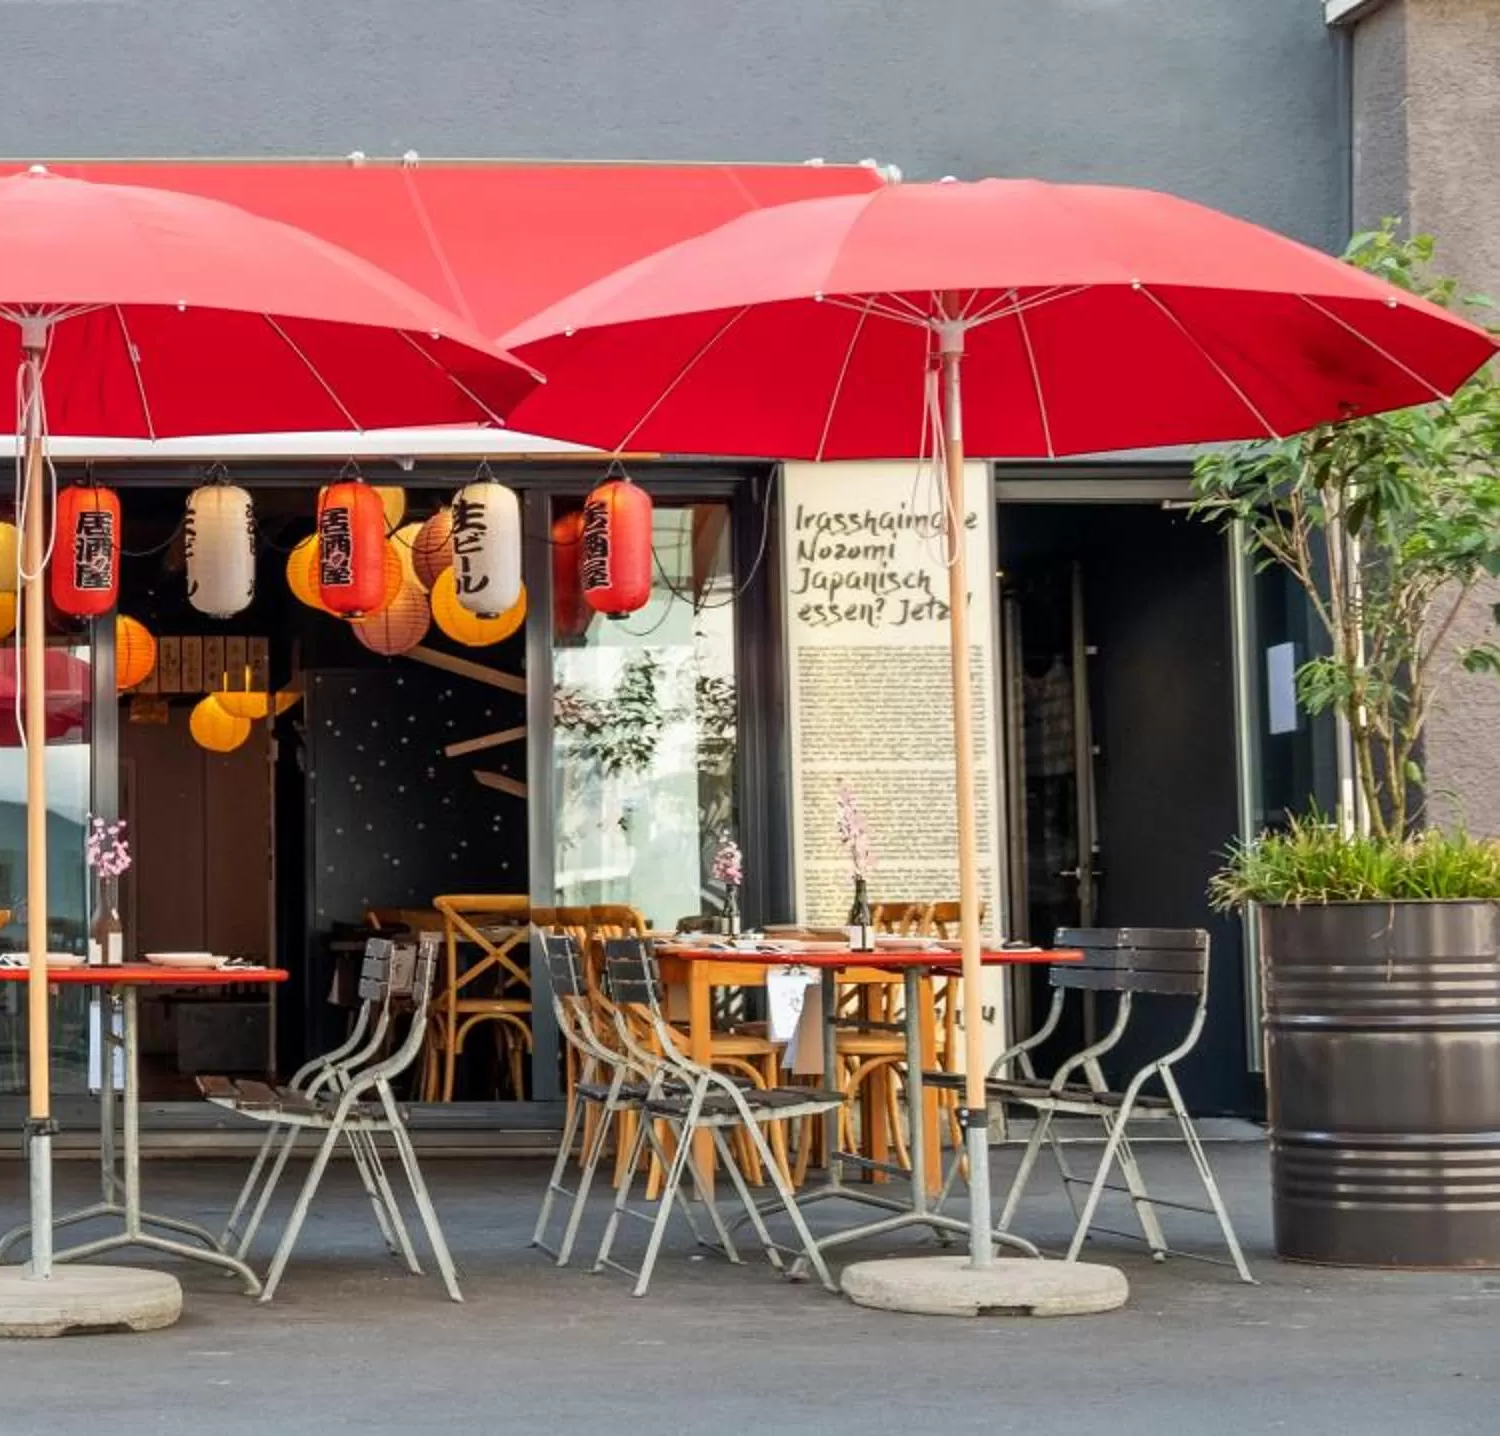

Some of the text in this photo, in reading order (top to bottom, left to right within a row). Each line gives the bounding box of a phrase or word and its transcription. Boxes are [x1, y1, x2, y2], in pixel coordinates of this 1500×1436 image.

[795, 502, 977, 536] Irasshaimae
[453, 498, 489, 595] 生ビール
[796, 531, 897, 562] Nozomi
[790, 566, 936, 602] Japanisch
[797, 591, 972, 628] essen? Jetz!
